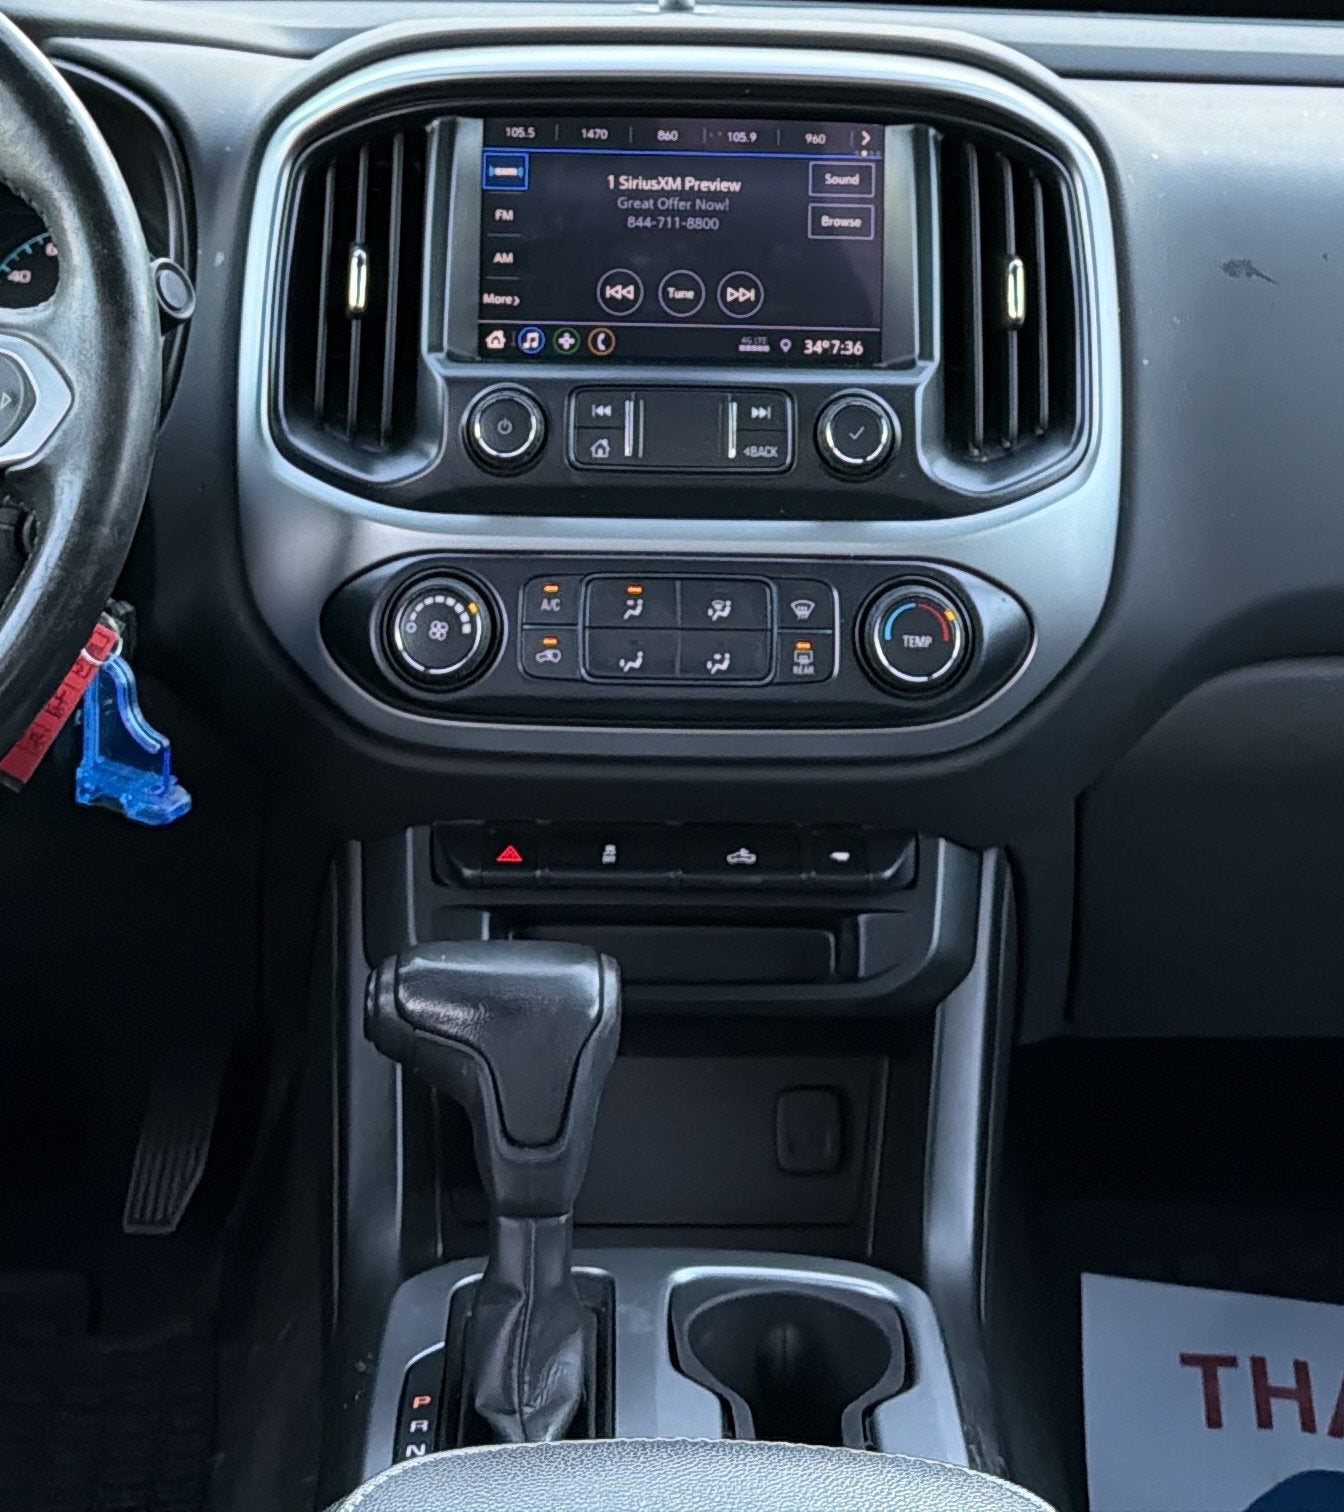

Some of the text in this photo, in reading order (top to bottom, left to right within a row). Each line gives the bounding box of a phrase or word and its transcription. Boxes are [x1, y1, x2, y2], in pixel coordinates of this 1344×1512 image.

[505, 125, 536, 139] 105.5
[580, 128, 609, 140] 1470
[656, 129, 679, 142] 860
[727, 130, 757, 143] 105.9
[805, 133, 826, 145] 960
[607, 174, 741, 193] 1 SiriusXM Preview
[824, 172, 860, 186] Sound
[617, 197, 730, 212] Great Offer Now!
[494, 209, 514, 222] FM
[820, 215, 862, 229] Browse
[626, 216, 719, 231] 844-711-8800
[493, 252, 514, 264] AM
[7, 270, 31, 283] 40
[483, 292, 512, 306] More
[667, 288, 695, 300] Tune
[831, 340, 864, 356] 7:36
[750, 445, 779, 458] BACK
[540, 599, 562, 612] A/C
[903, 635, 934, 649] TEMP
[793, 665, 816, 675] REAR
[412, 1395, 432, 1409] P
[409, 1419, 429, 1433] R
[405, 1443, 426, 1458] N
